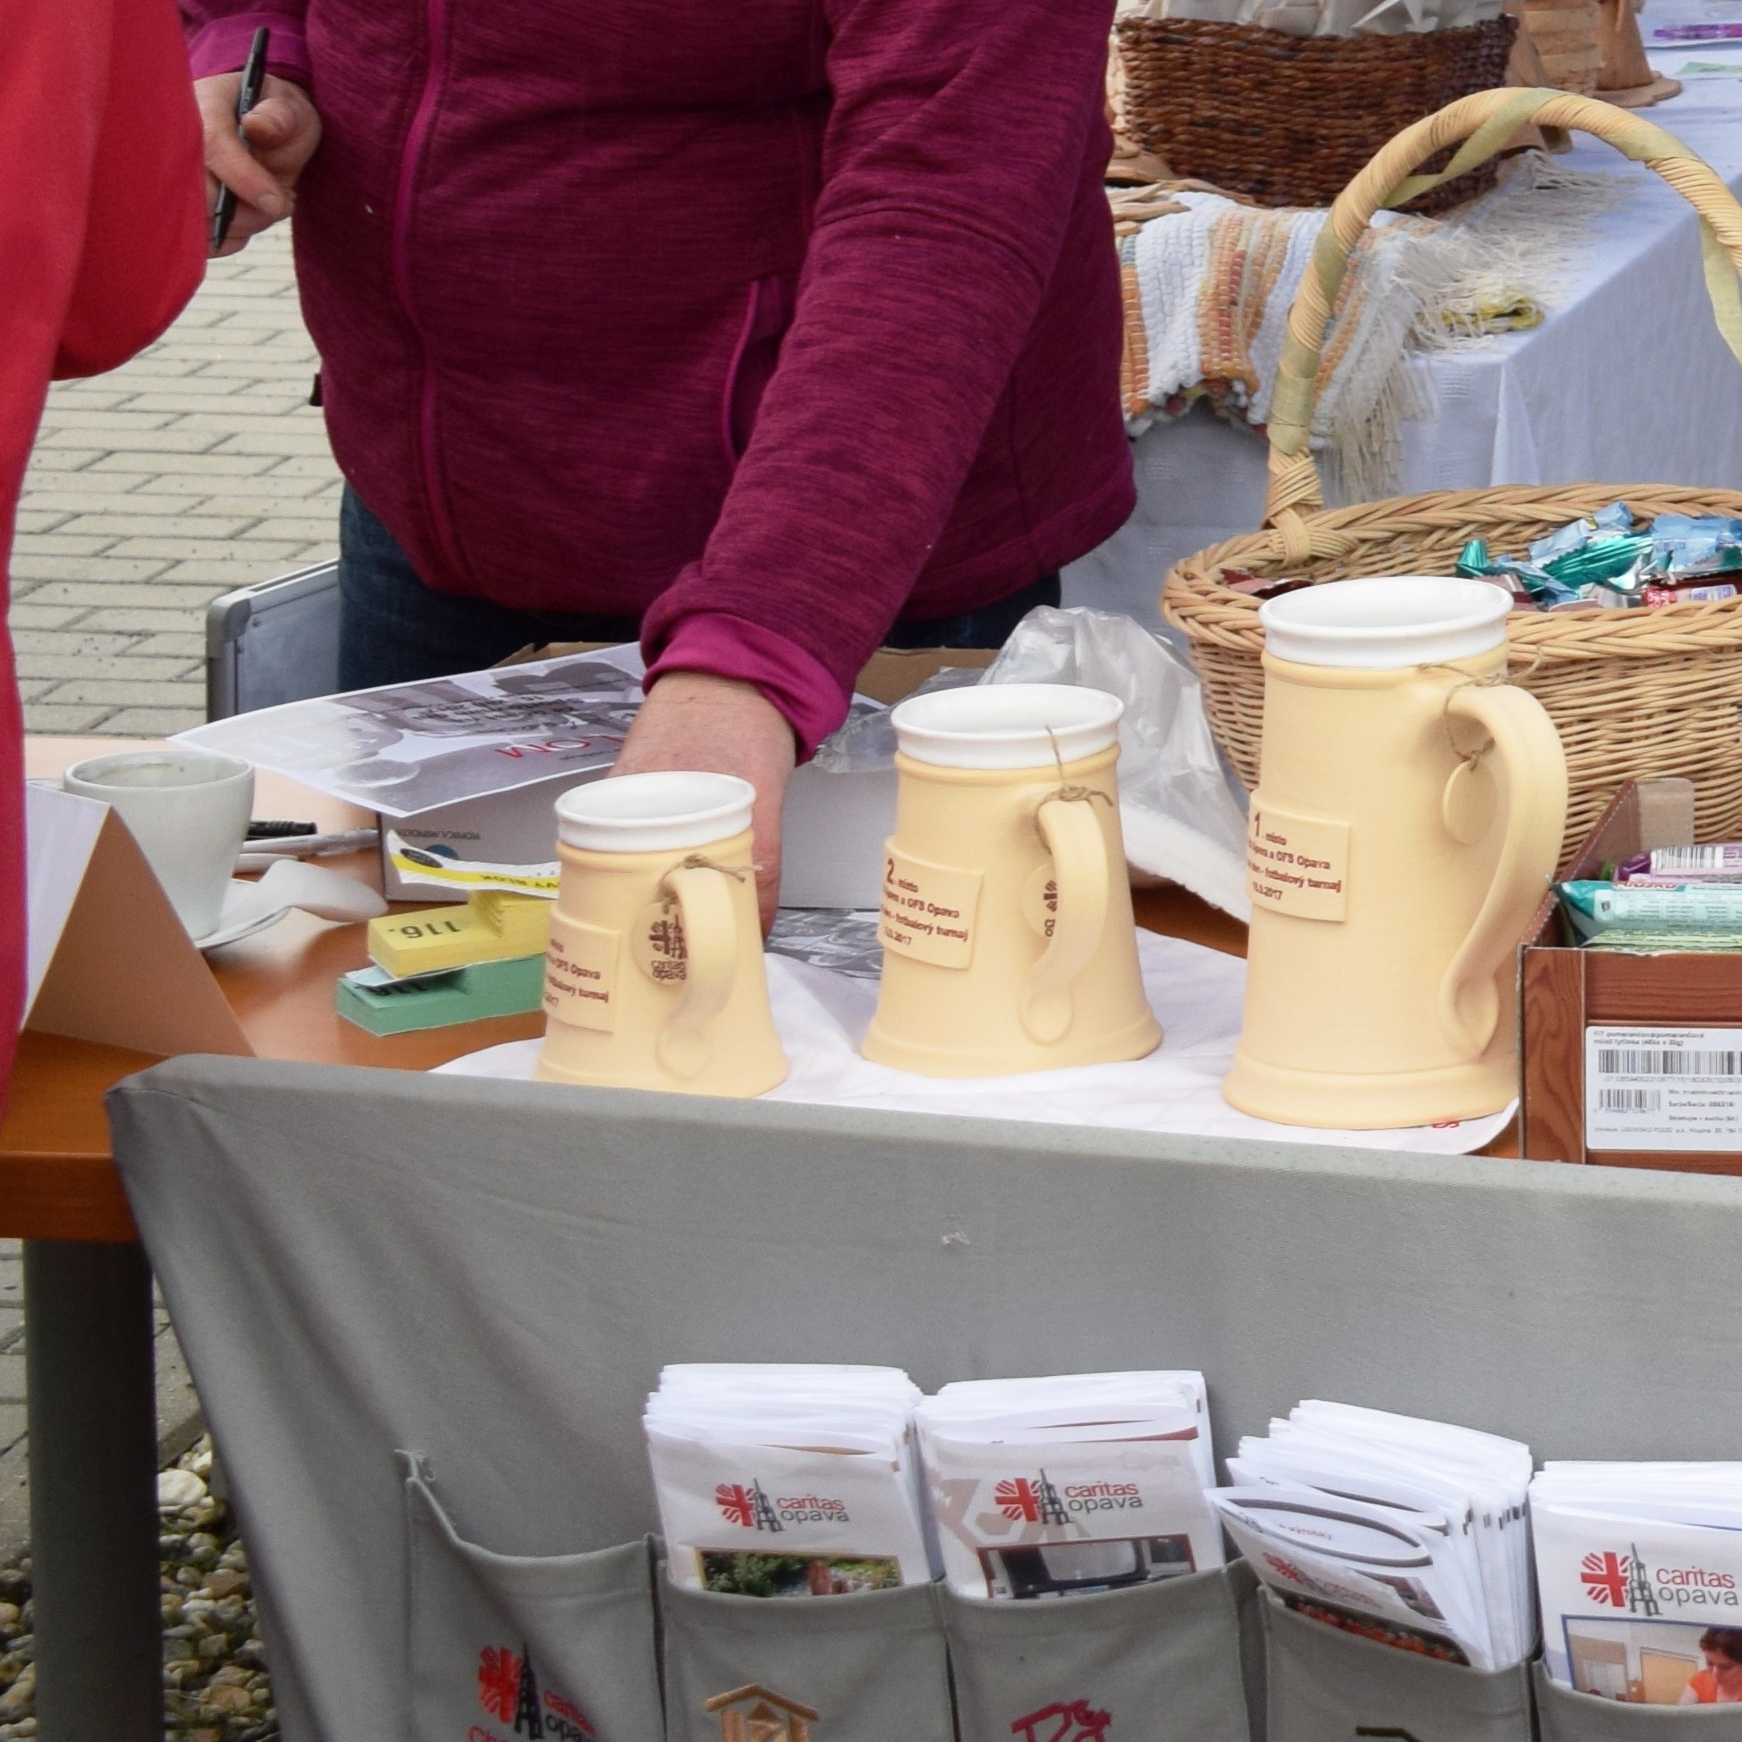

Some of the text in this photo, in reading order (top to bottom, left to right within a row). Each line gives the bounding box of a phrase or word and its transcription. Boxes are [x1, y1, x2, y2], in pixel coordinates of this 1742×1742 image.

[1297, 855, 1331, 870] Opava
[1308, 877, 1342, 894] turnaj
[937, 926, 968, 942] turnaj
[1064, 1478, 1139, 1498] caritas
[775, 1492, 845, 1512] caritas
[1068, 1493, 1144, 1513] opava
[780, 1506, 850, 1525] opava
[1654, 1565, 1735, 1588] caritas
[1658, 1585, 1740, 1608] opava
